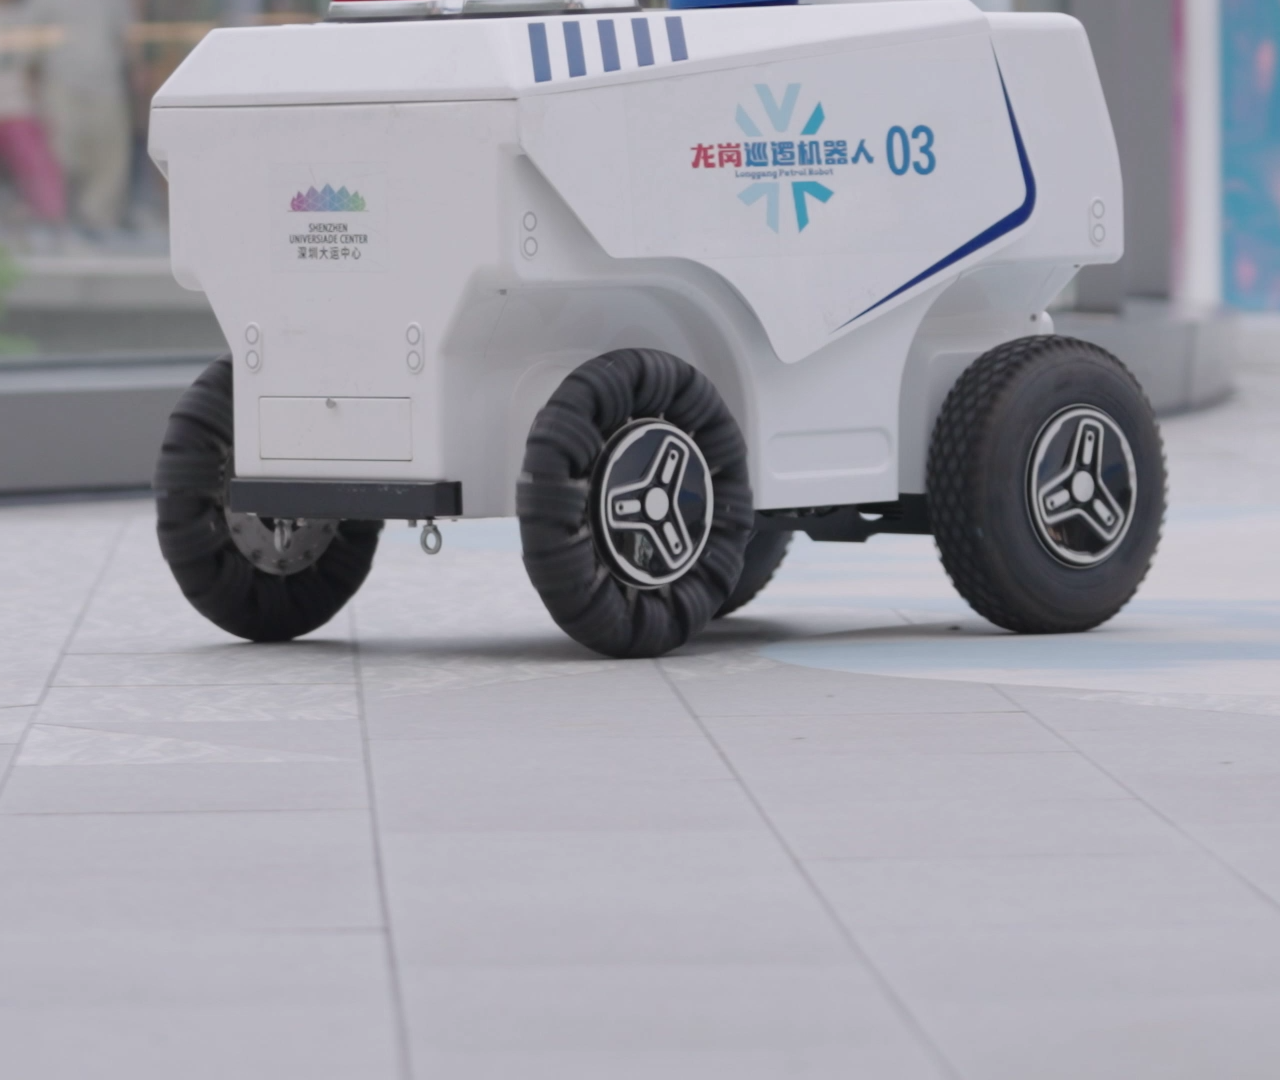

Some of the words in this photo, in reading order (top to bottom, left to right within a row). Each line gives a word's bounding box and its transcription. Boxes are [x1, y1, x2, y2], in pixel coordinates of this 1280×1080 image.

[690, 139, 874, 169] 龙岗巡逻机器人
[886, 124, 937, 176] 03
[308, 223, 348, 233] SHENZHEN
[289, 234, 338, 244] UNIVERSIADE
[339, 234, 368, 244] CENTER
[297, 246, 362, 260] 深圳大运中心
